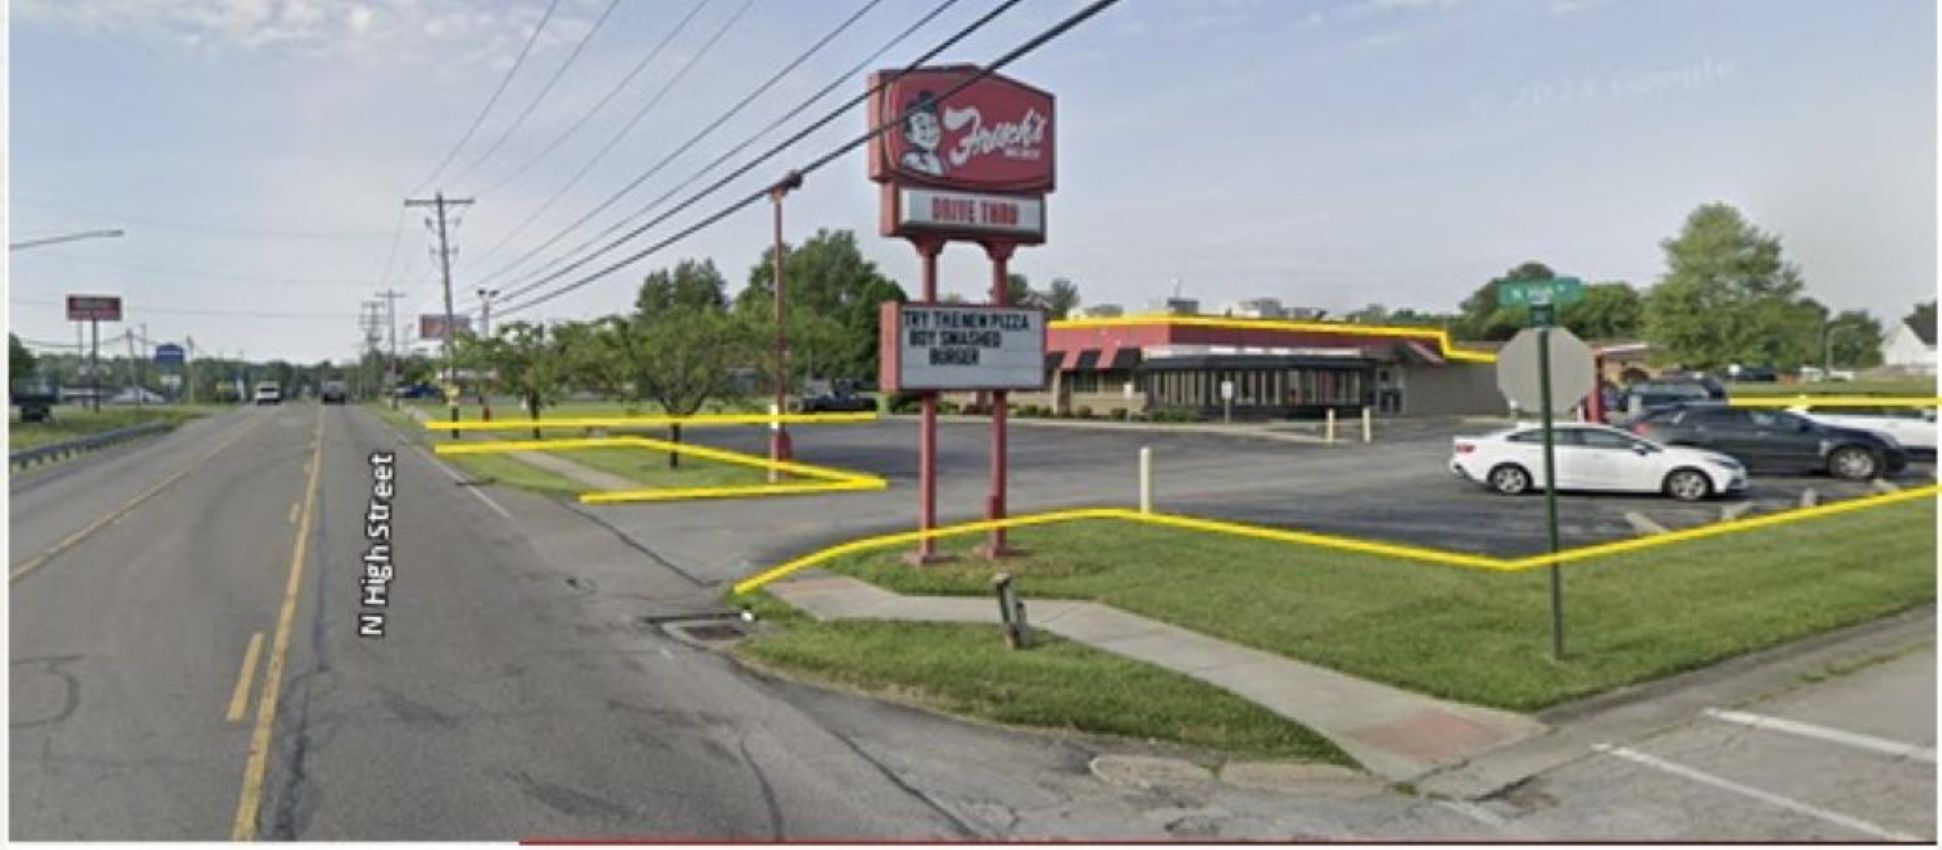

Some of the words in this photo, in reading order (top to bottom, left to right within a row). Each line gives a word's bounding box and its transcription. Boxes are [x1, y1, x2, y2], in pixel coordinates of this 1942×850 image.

[932, 197, 976, 224] DRIVE
[979, 199, 1019, 226] THRU
[904, 311, 929, 327] TRY
[991, 314, 1030, 332] PIZZA
[909, 330, 937, 347] BOY
[940, 330, 1002, 348] SMASHED
[929, 347, 981, 367] BURGER
